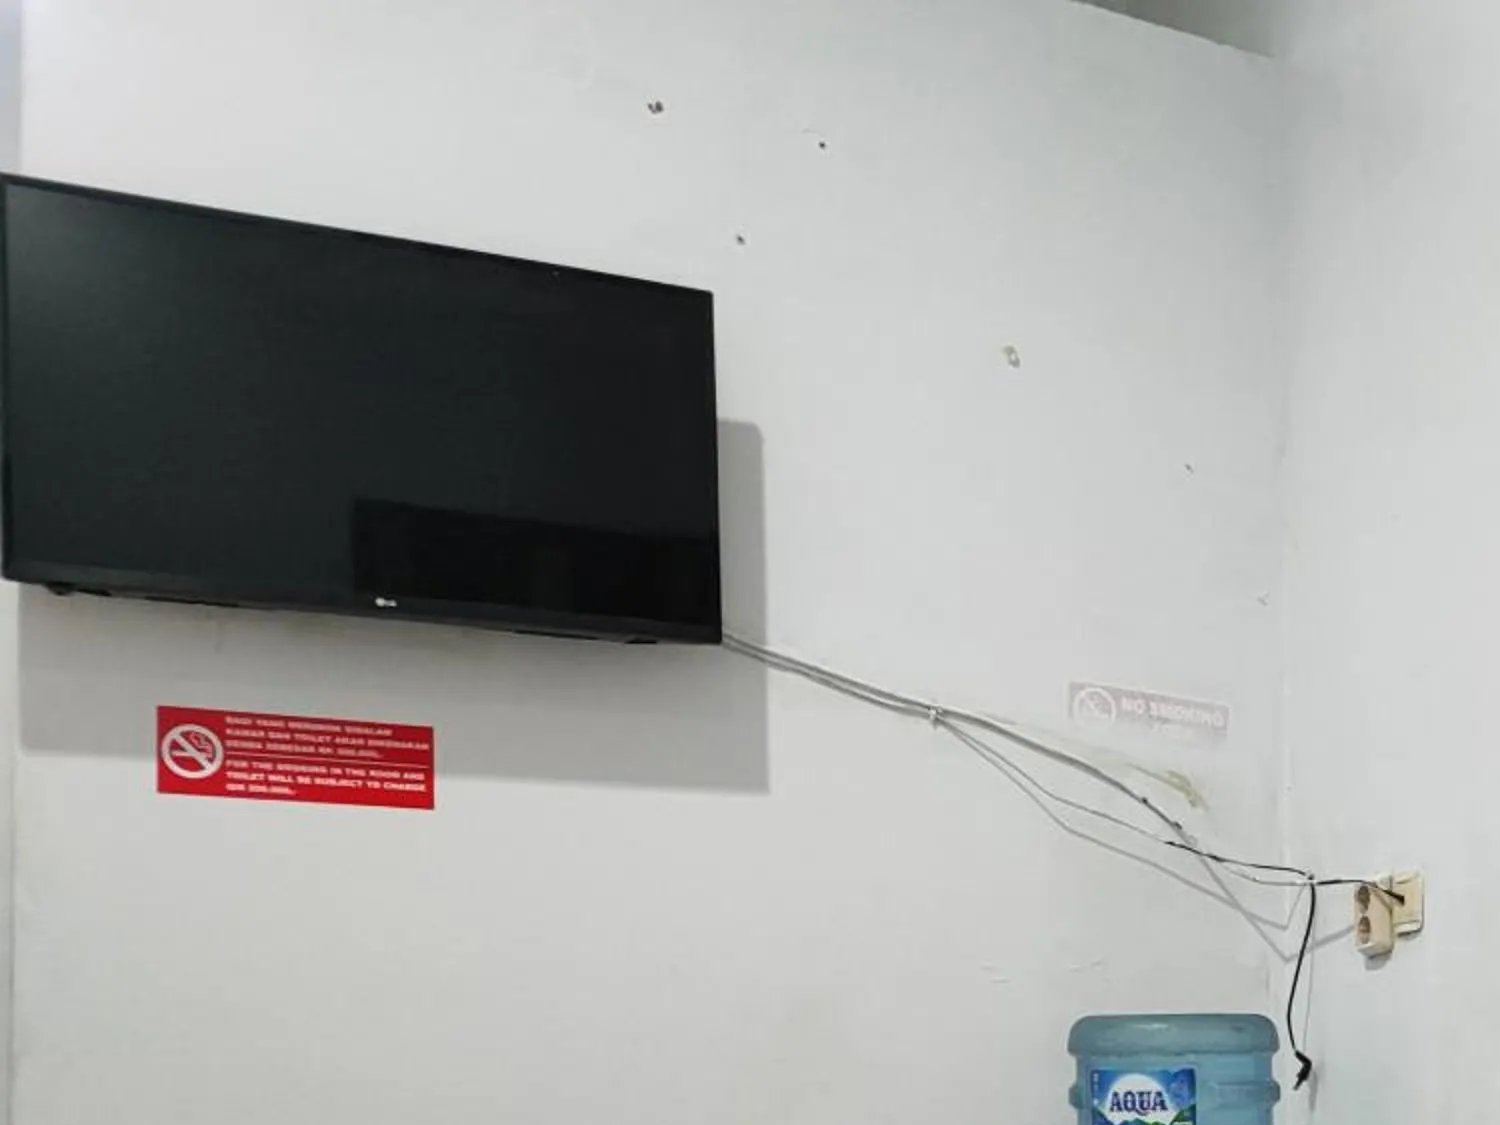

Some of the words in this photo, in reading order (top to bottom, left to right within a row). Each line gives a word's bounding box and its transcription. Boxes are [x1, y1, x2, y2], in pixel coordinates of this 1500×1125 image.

[1120, 696, 1145, 714] NO
[293, 733, 332, 743] TOILET
[225, 760, 248, 768] FOR
[251, 762, 273, 770] THE
[345, 768, 366, 777] THE
[369, 769, 400, 778] ROOM
[403, 772, 425, 780] AND
[226, 771, 264, 780] TOILET
[268, 774, 295, 783] WILL
[296, 776, 311, 784] BE
[313, 777, 363, 788] SUBJECT
[366, 781, 380, 789] TO
[1109, 1090, 1168, 1116] AQUA
